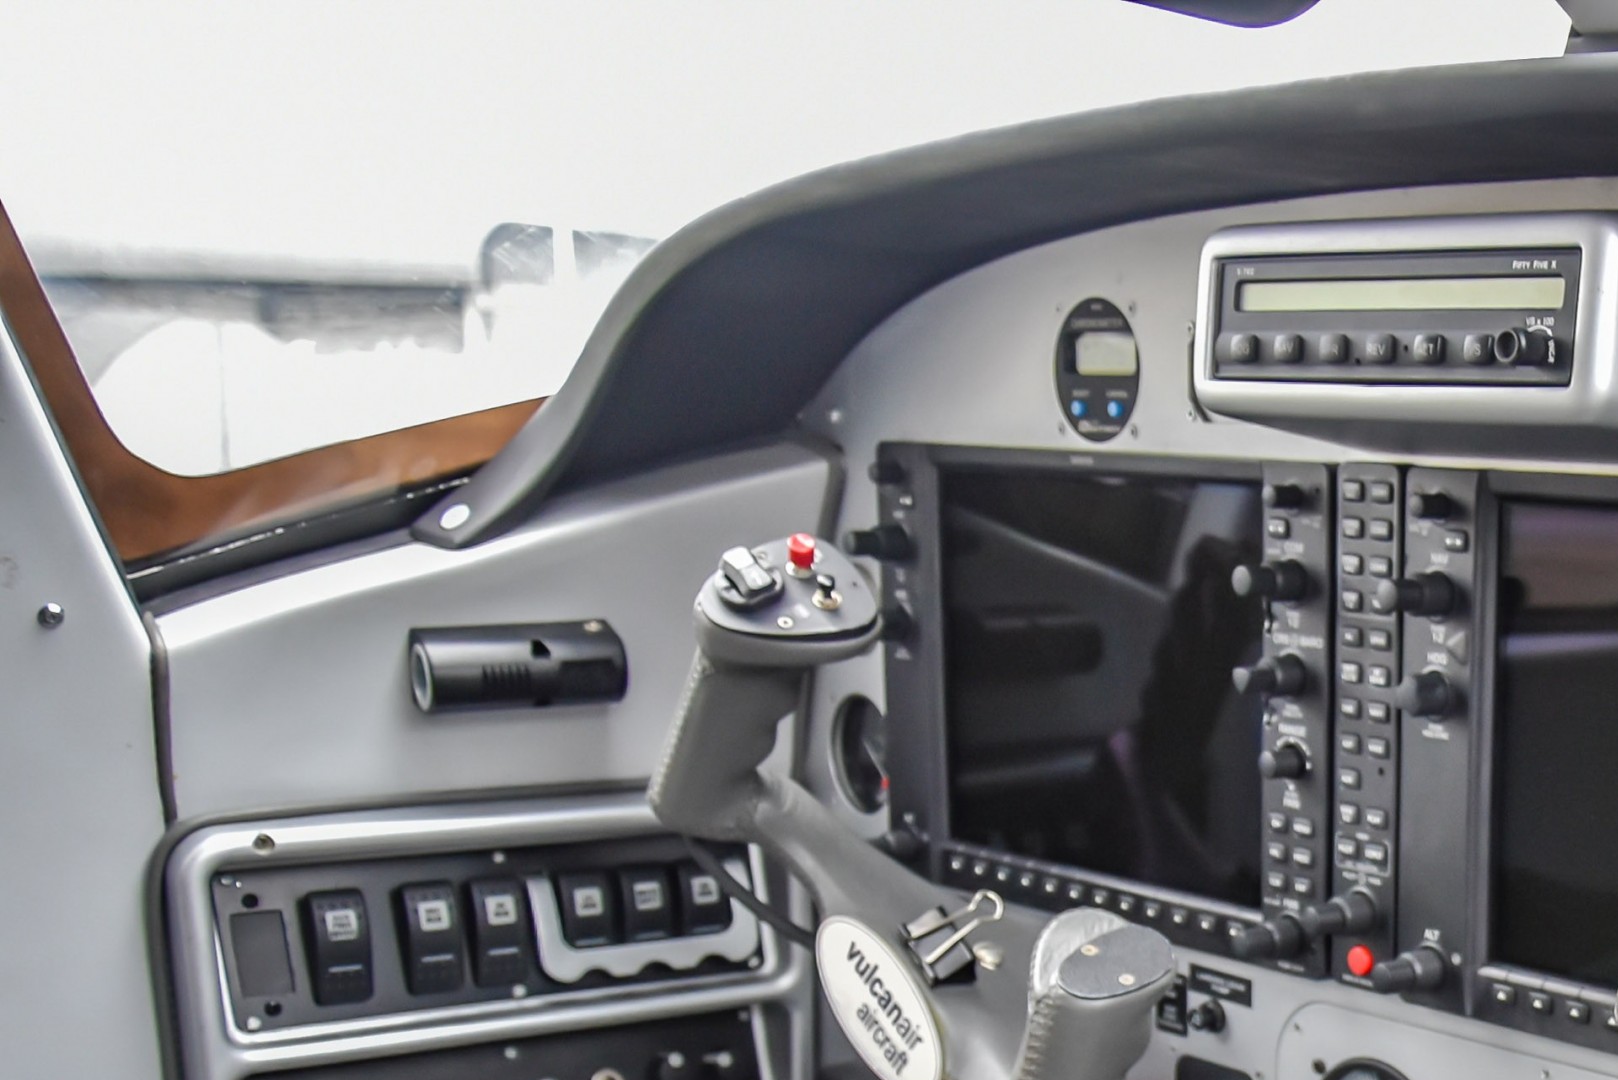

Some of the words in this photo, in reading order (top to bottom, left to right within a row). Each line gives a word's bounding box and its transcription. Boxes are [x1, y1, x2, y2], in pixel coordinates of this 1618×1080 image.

[1424, 929, 1441, 941] ALT
[849, 943, 924, 1050] vulcanair
[857, 1003, 910, 1075] aircraft
